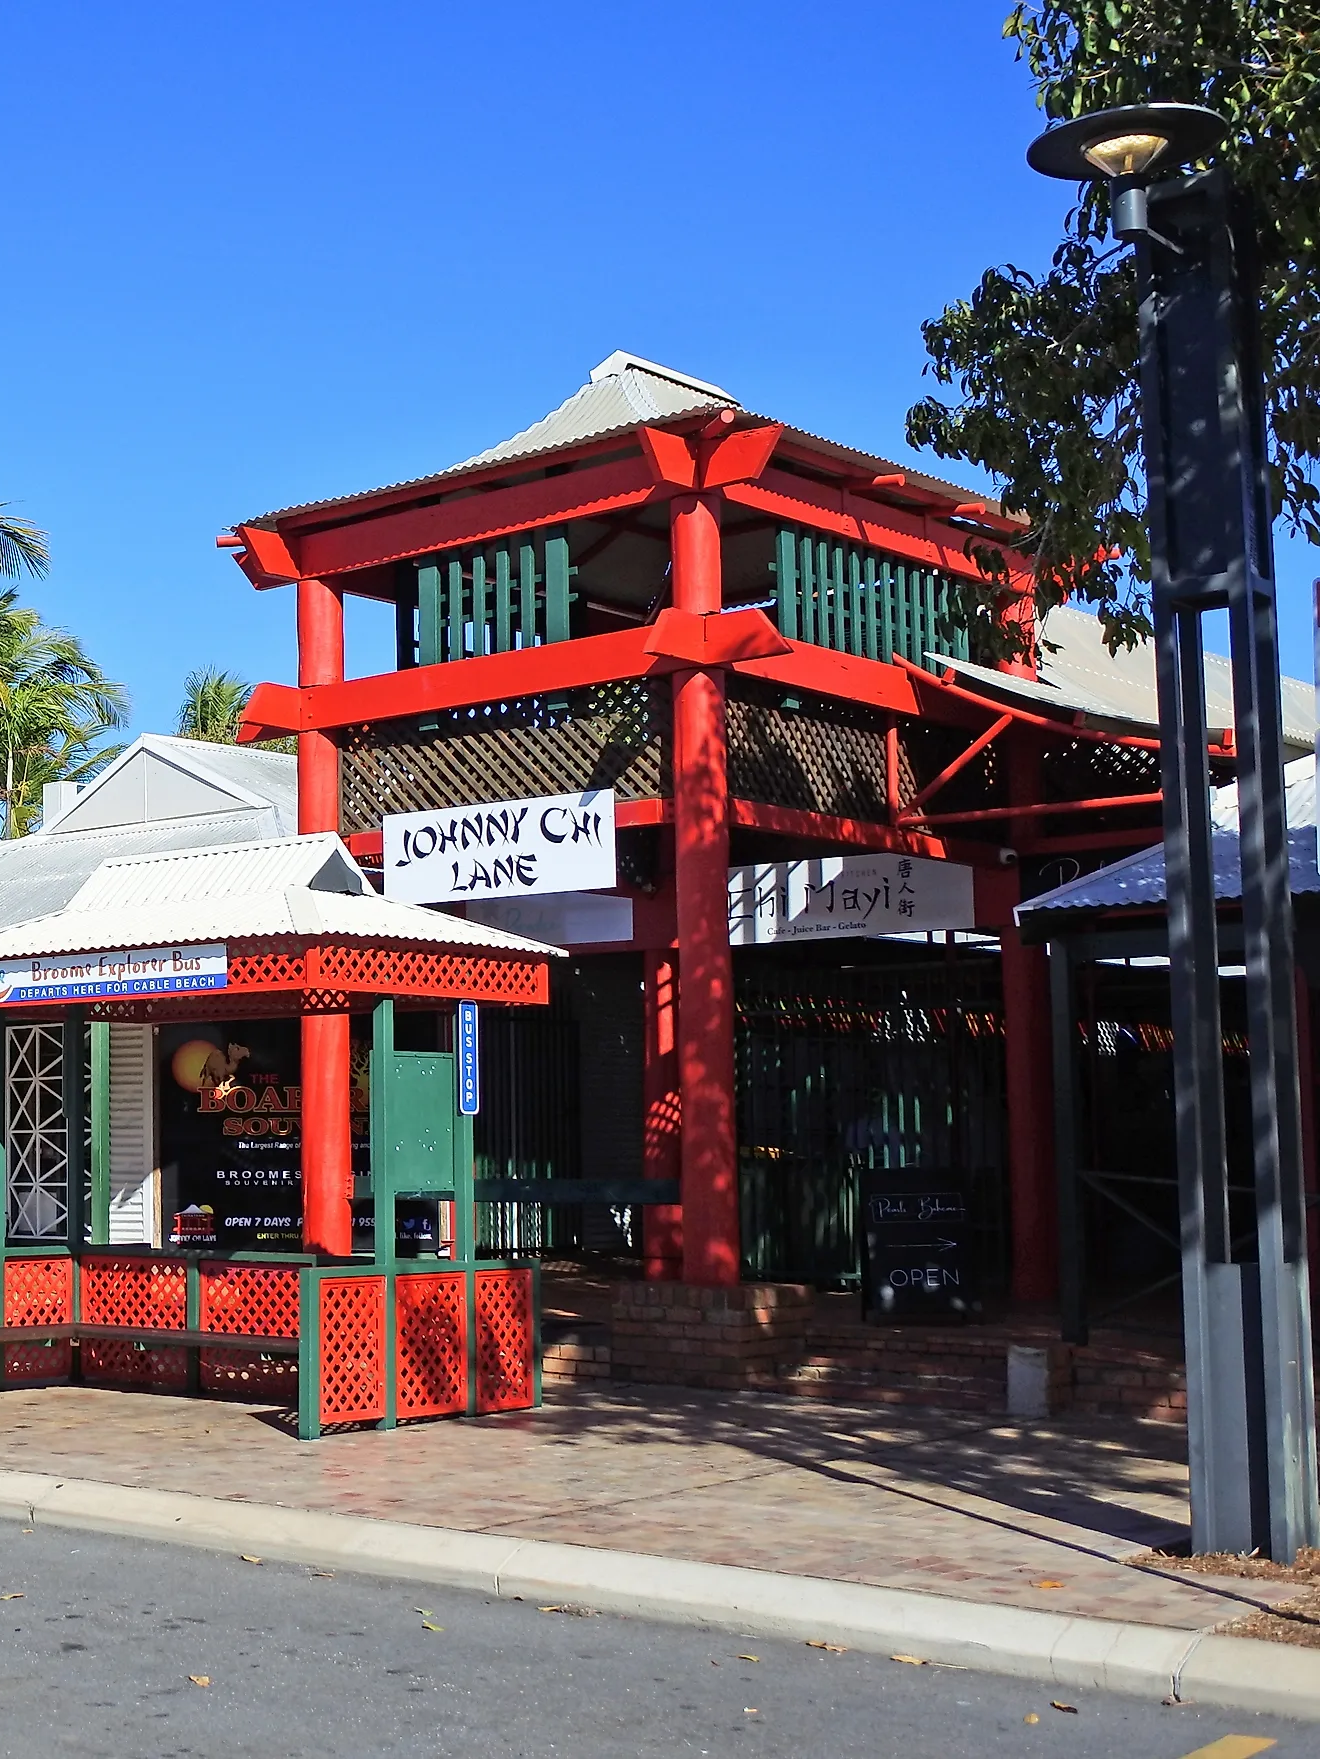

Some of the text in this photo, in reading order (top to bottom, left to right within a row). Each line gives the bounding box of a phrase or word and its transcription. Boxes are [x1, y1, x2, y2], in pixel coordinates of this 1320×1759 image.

[395, 806, 602, 867] JOHNNY CHI
[449, 852, 539, 892] LANE
[896, 858, 915, 918] 唐人街
[791, 925, 814, 936] Juice
[815, 923, 832, 932] Bar
[837, 921, 867, 931] Gelato
[31, 950, 202, 982] Broome Explorer Bus
[20, 976, 215, 999] DEPARTS HERE FOR CABLE BEACH
[464, 1010, 473, 1103] BUS STOP
[249, 1073, 279, 1084] THE
[224, 1217, 252, 1227] OPEN
[254, 1217, 262, 1227] 7
[264, 1216, 291, 1227] DAYS
[256, 1232, 279, 1240] ENTER
[889, 1268, 960, 1287] OPEN
